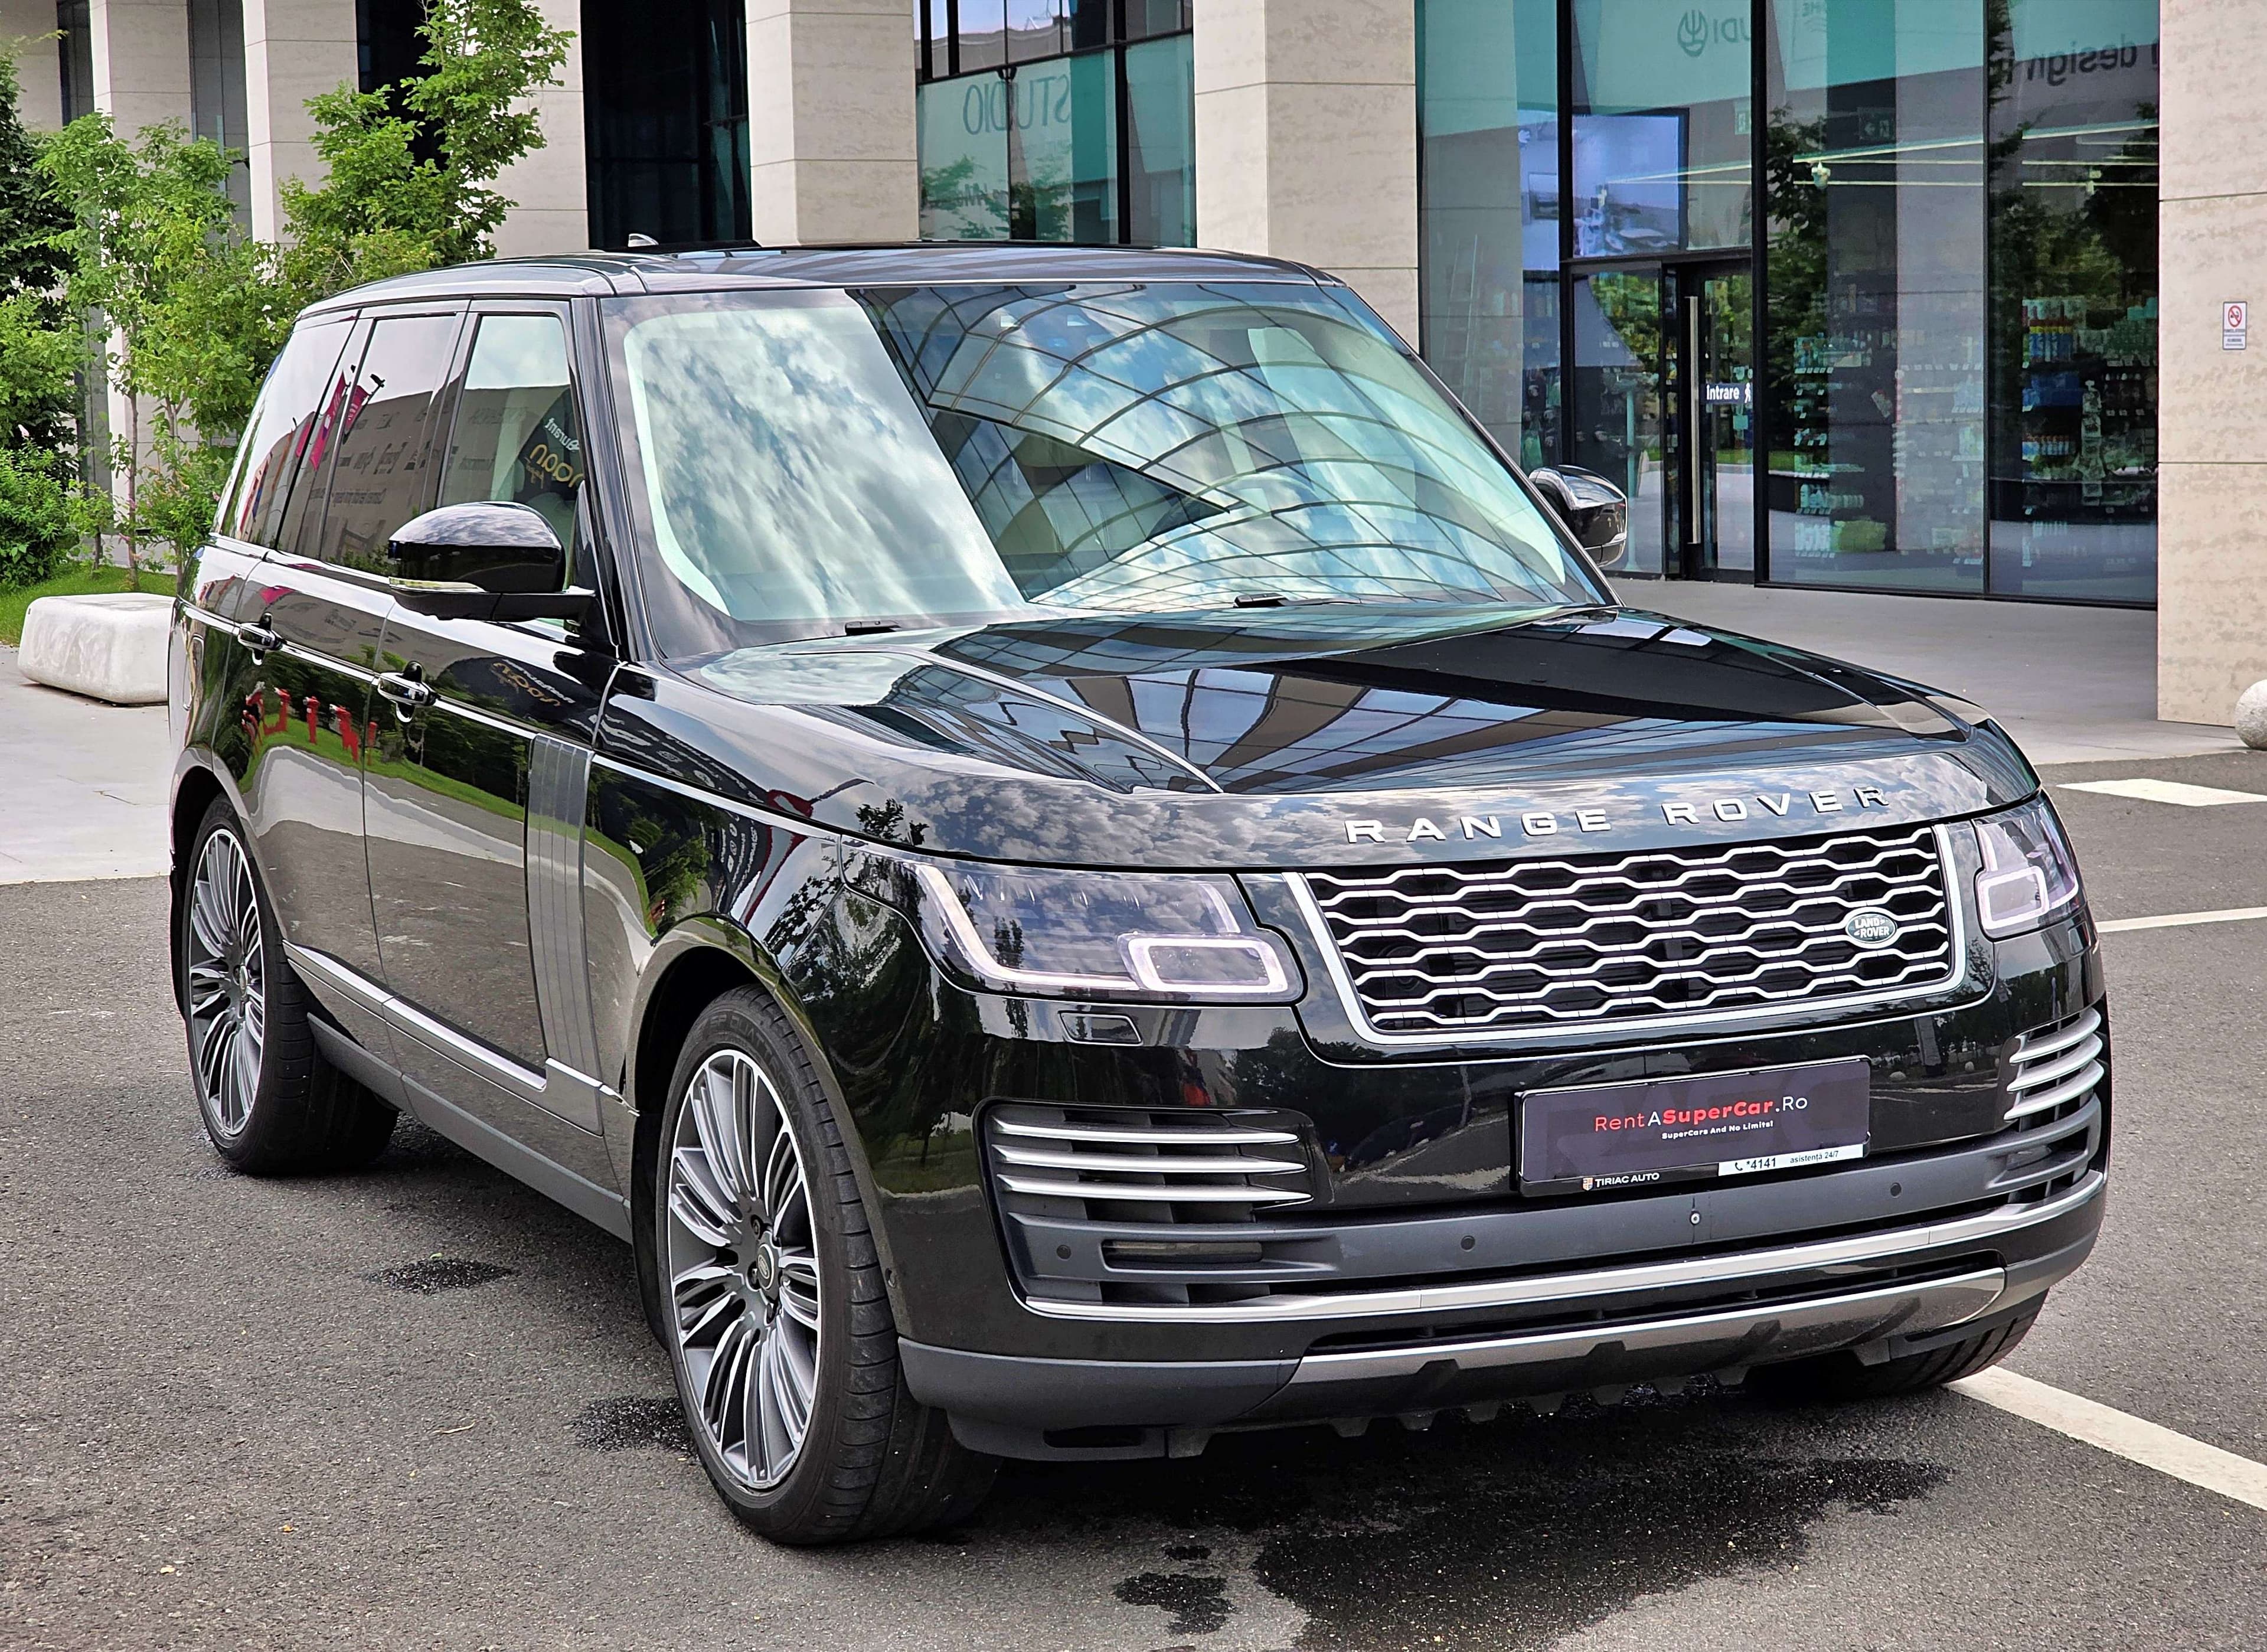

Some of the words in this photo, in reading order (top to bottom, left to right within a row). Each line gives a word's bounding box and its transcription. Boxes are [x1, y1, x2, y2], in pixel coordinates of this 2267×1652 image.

[1345, 808, 1612, 843] RANGE
[1661, 786, 1889, 826] ROVER
[1854, 918, 1880, 929] LAND
[1860, 926, 1889, 938] ROVER
[1595, 1096, 1808, 1131] RentASuperCar.Ro
[1662, 1129, 1709, 1140] SuperCars
[1710, 1125, 1726, 1134] And
[1743, 1120, 1773, 1130] Limits!
[1825, 1151, 1839, 1159] 24/7
[1595, 1176, 1629, 1188] TIRIAC
[1631, 1172, 1660, 1183] AUTO
